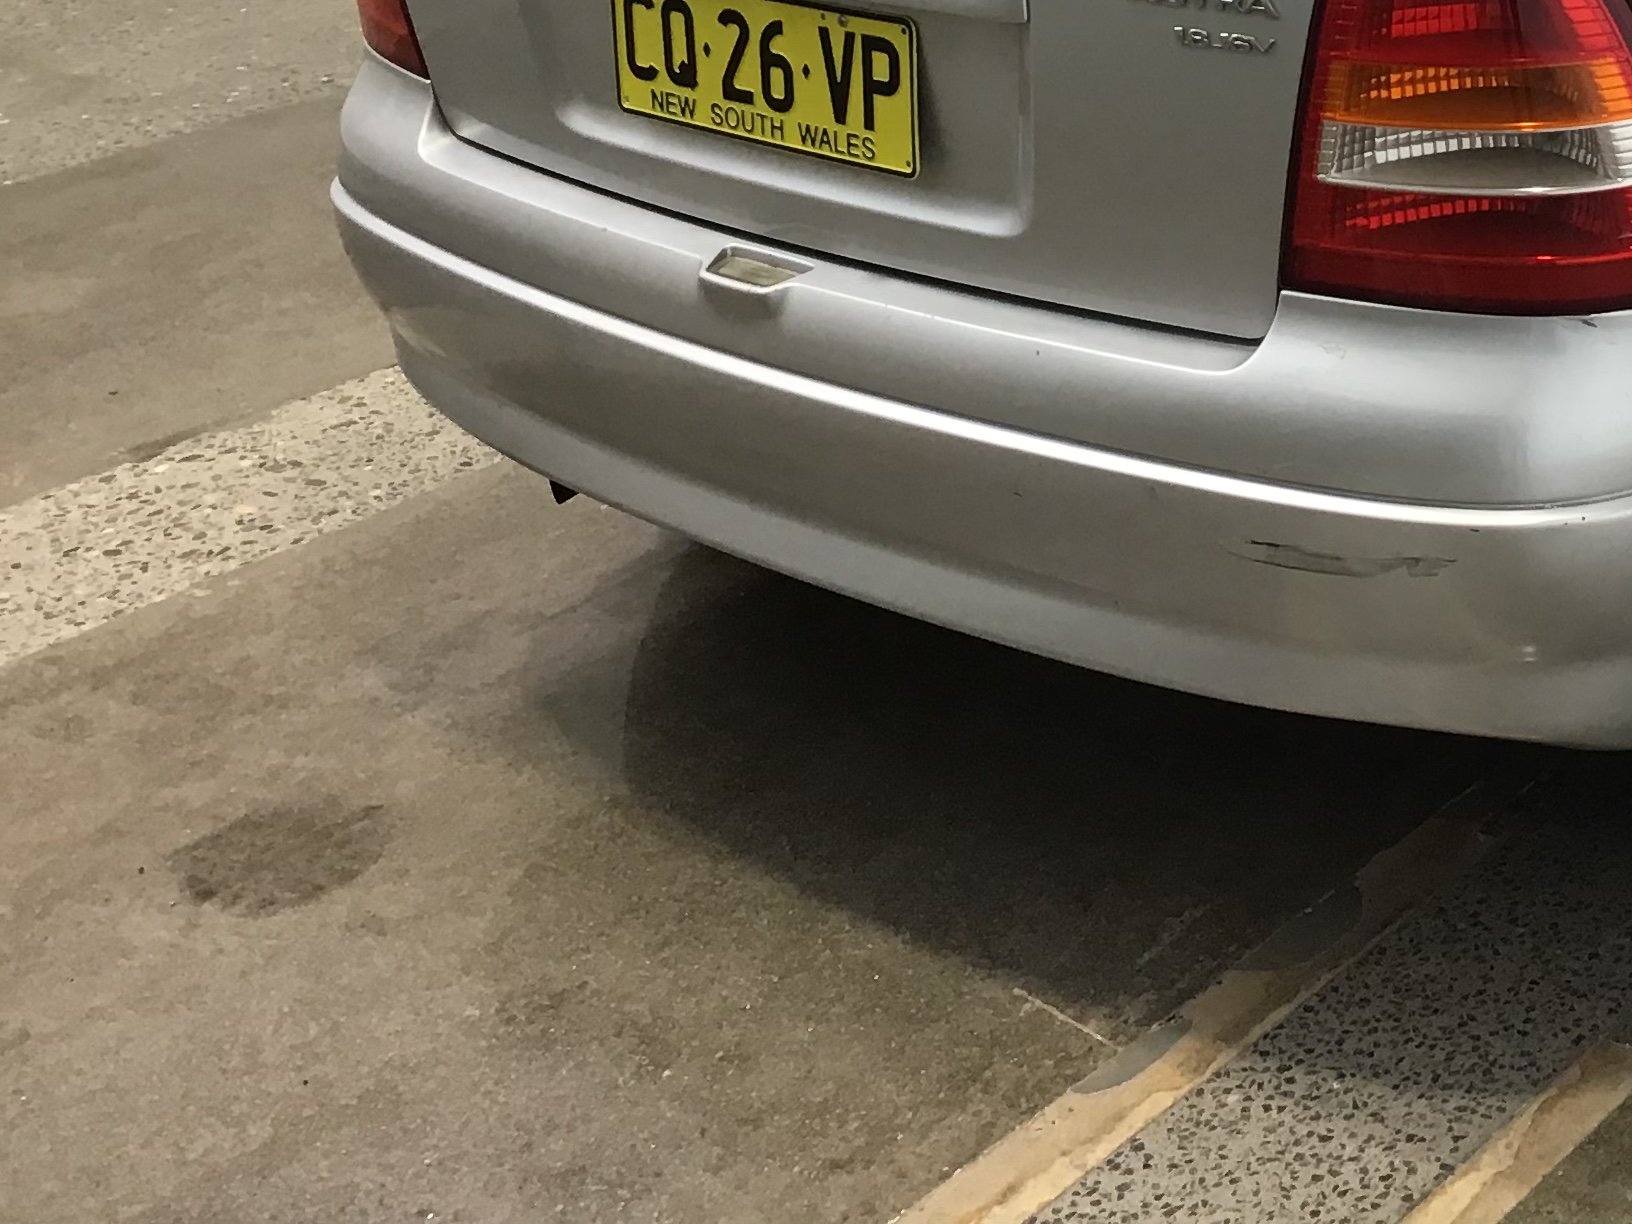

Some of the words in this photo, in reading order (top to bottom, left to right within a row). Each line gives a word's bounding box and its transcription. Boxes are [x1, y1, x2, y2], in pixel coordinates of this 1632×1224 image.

[651, 88, 696, 119] NEW
[711, 102, 784, 140] SOUTH
[798, 122, 876, 160] WALES
